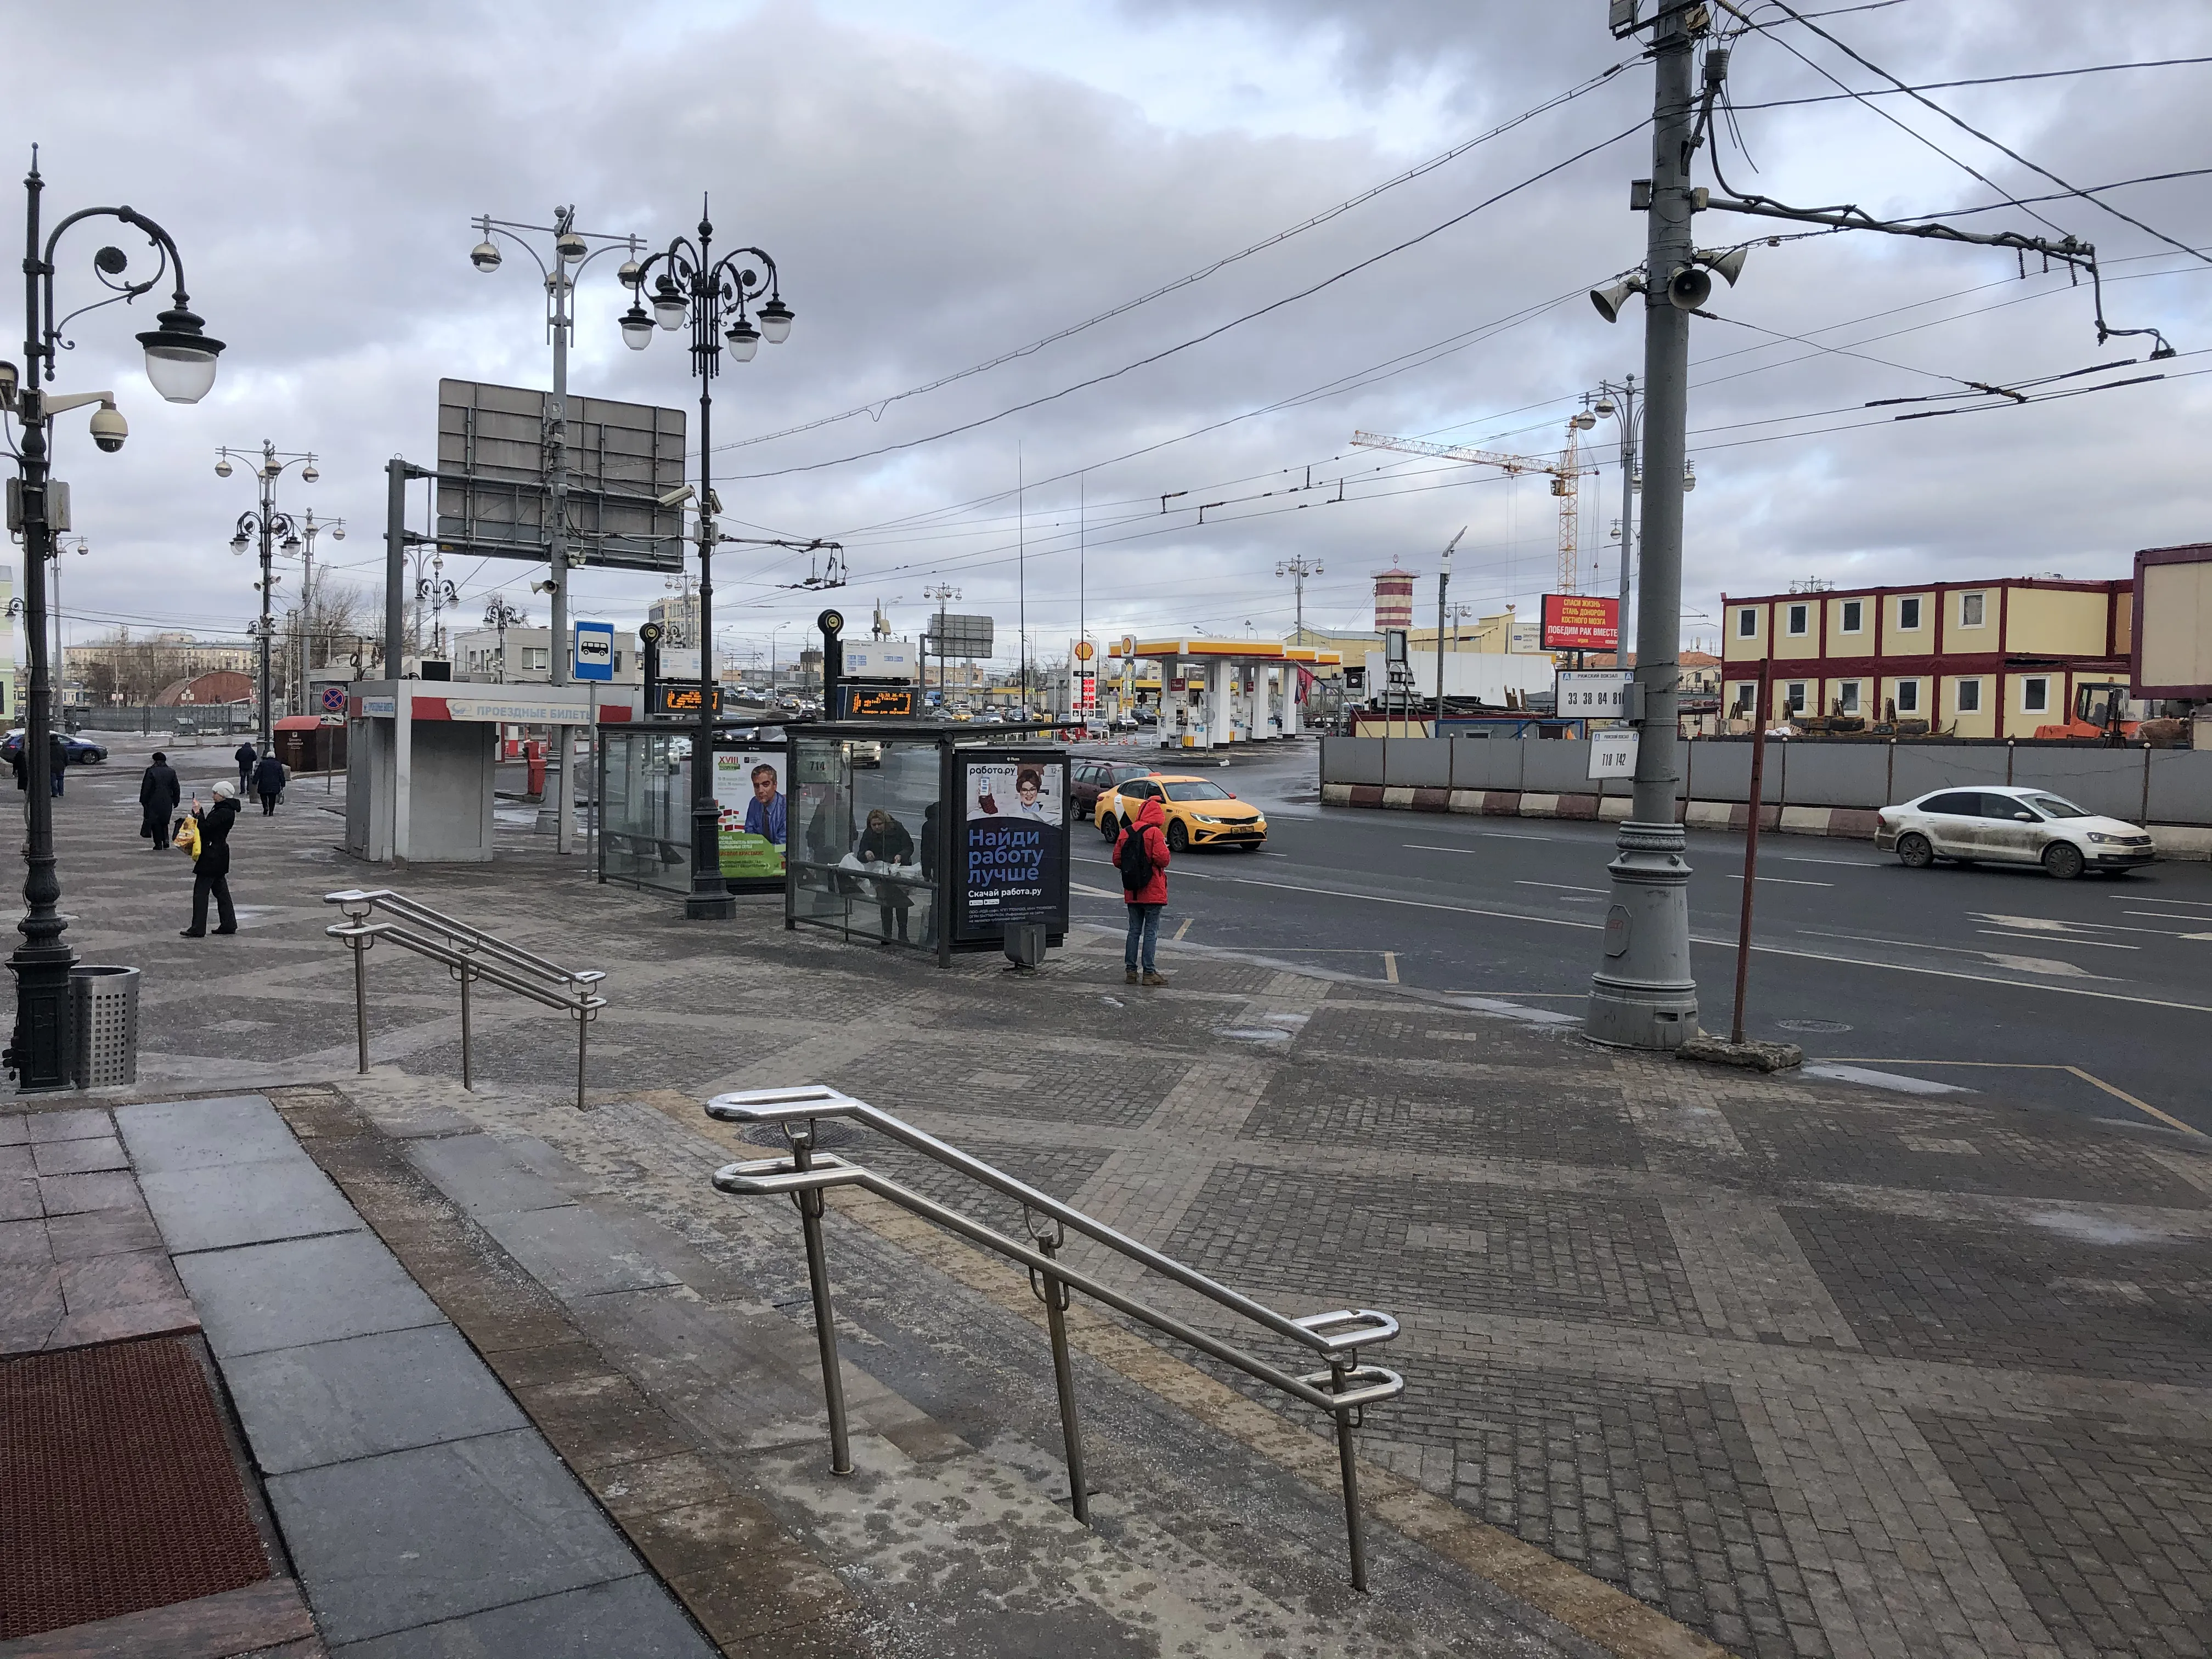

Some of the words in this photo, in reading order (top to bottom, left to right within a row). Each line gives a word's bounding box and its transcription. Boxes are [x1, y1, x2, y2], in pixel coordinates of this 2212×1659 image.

[1564, 599, 1581, 607] СПАСИ
[1582, 600, 1601, 608] ЖИЗНЬ
[1579, 608, 1606, 617] ДОНОРОМ
[1561, 616, 1587, 624] КОСТНОГО
[1548, 625, 1578, 635] ПОБЕДИМ
[1579, 627, 1592, 636] РАК
[1593, 628, 1618, 637] ВМЕСТЕ
[1568, 692, 1577, 704] 33
[1583, 692, 1592, 704] 38
[1598, 692, 1607, 704] 84
[477, 706, 547, 719] ПРОЕЗДНЫЕ
[1602, 753, 1613, 766] Т18
[1616, 753, 1626, 766] Т42
[810, 761, 825, 771] 714
[969, 766, 1015, 776] работа.ру
[969, 827, 1039, 847] Найди
[969, 845, 1044, 869] работу
[968, 867, 1039, 887] лучше
[968, 889, 999, 898] Скачай
[1001, 888, 1042, 898] работа.ру
